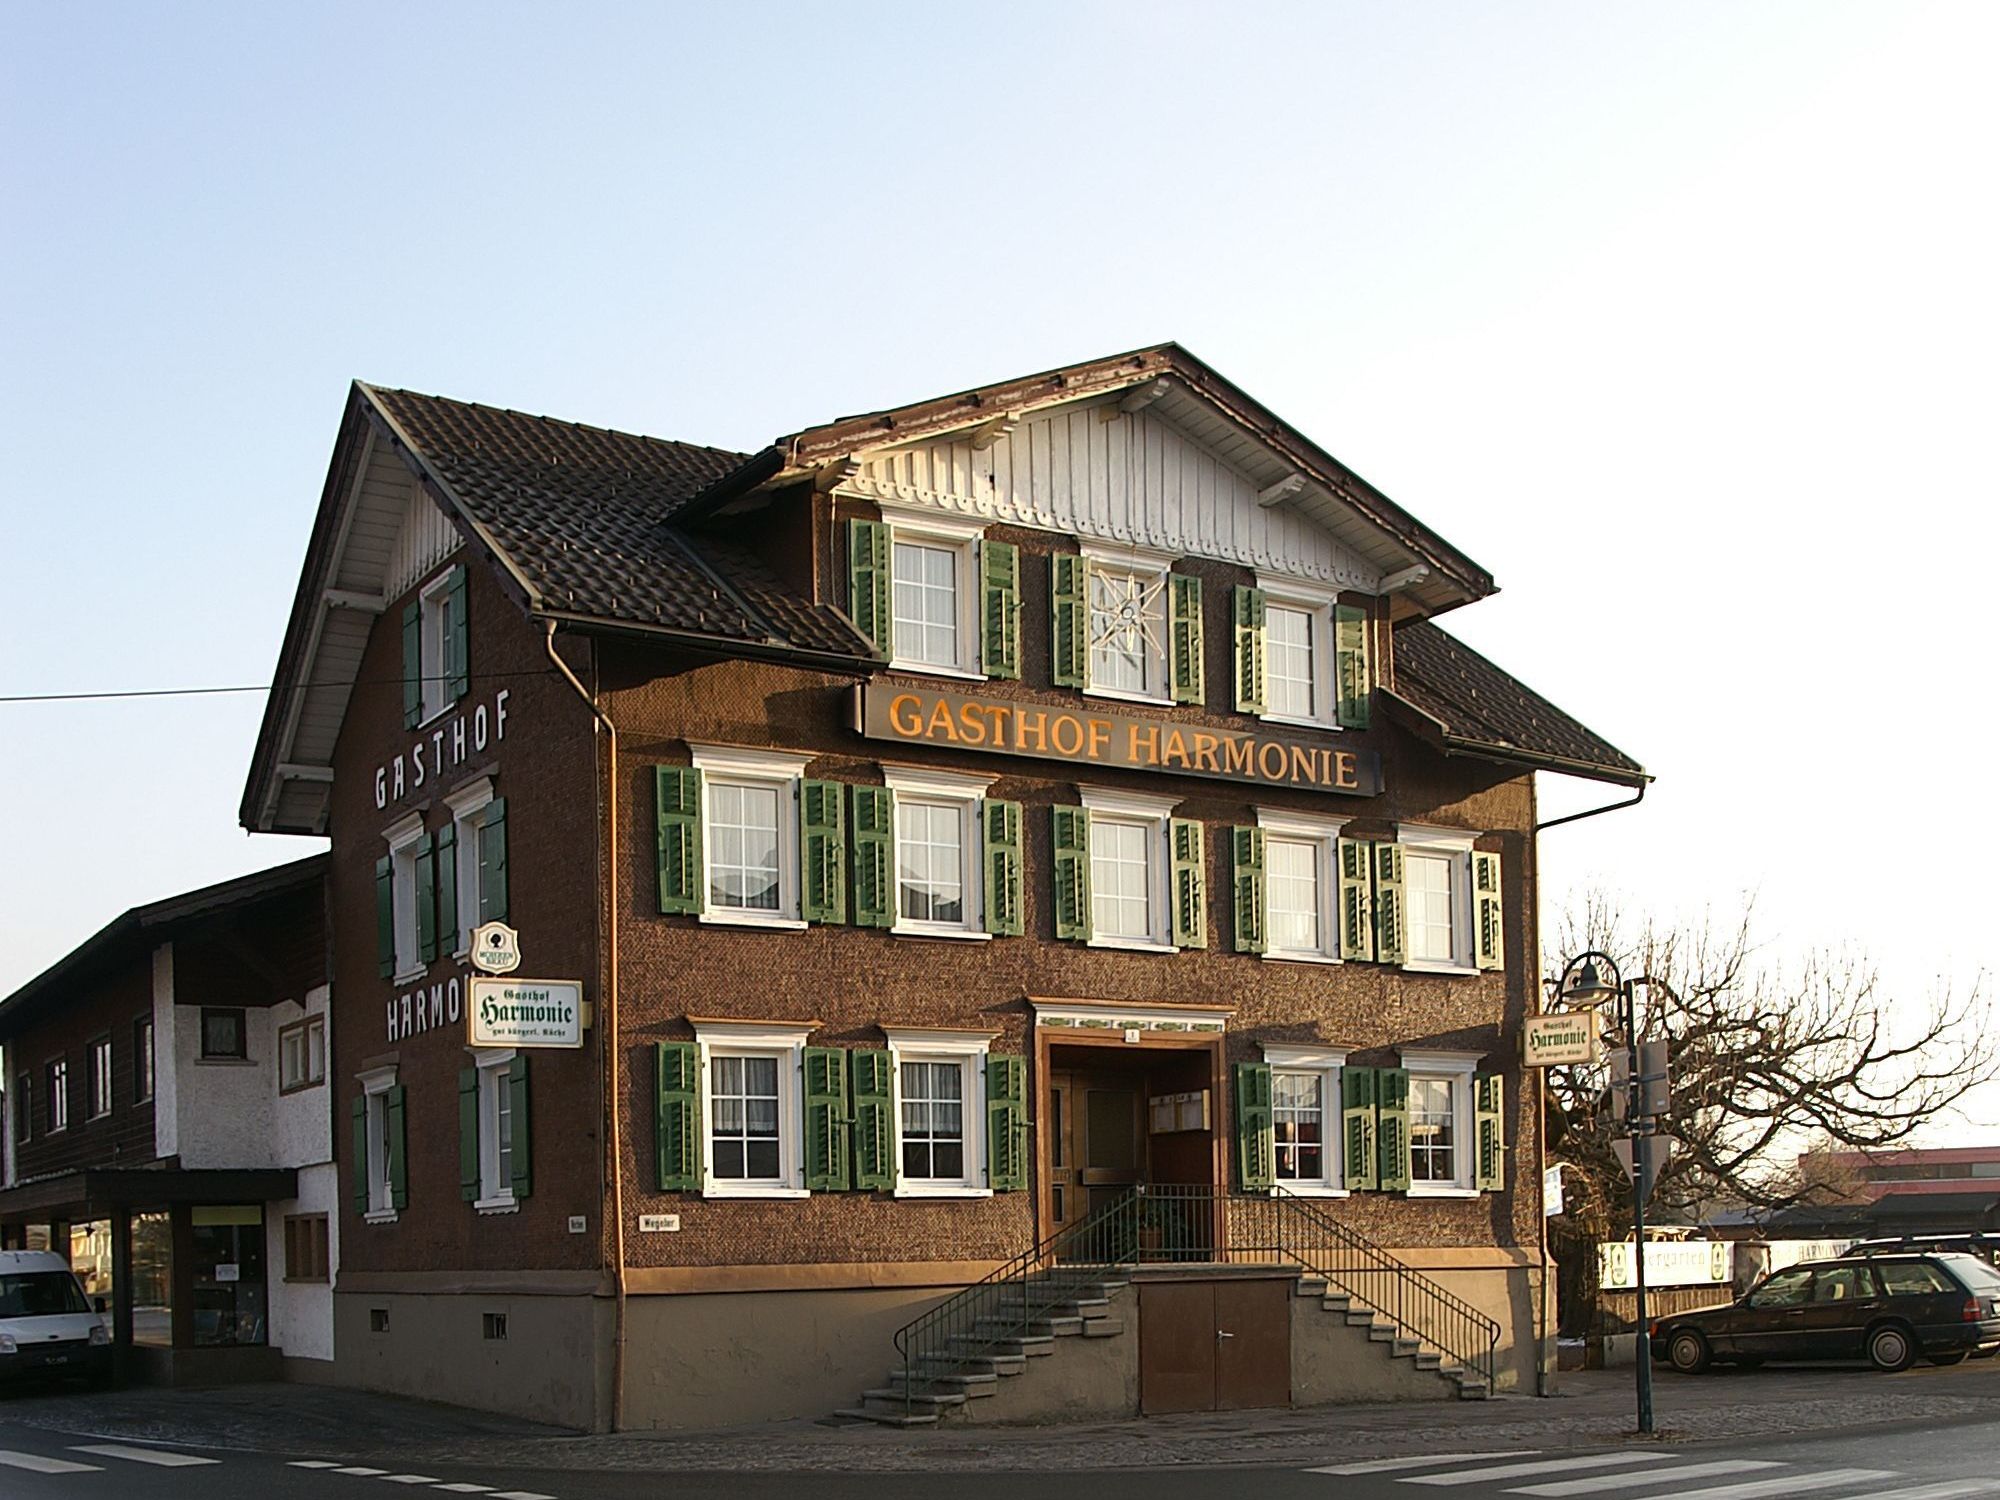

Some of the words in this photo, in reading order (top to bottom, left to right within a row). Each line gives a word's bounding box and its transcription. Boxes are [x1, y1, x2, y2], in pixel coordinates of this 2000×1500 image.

[375, 689, 509, 809] GASTHOF
[889, 694, 1113, 758] GASTHOF
[1128, 723, 1360, 789] HARMONIE
[480, 995, 573, 1027] Harmonie
[503, 989, 550, 1003] Gasthof
[1529, 1027, 1587, 1051] Harmonie
